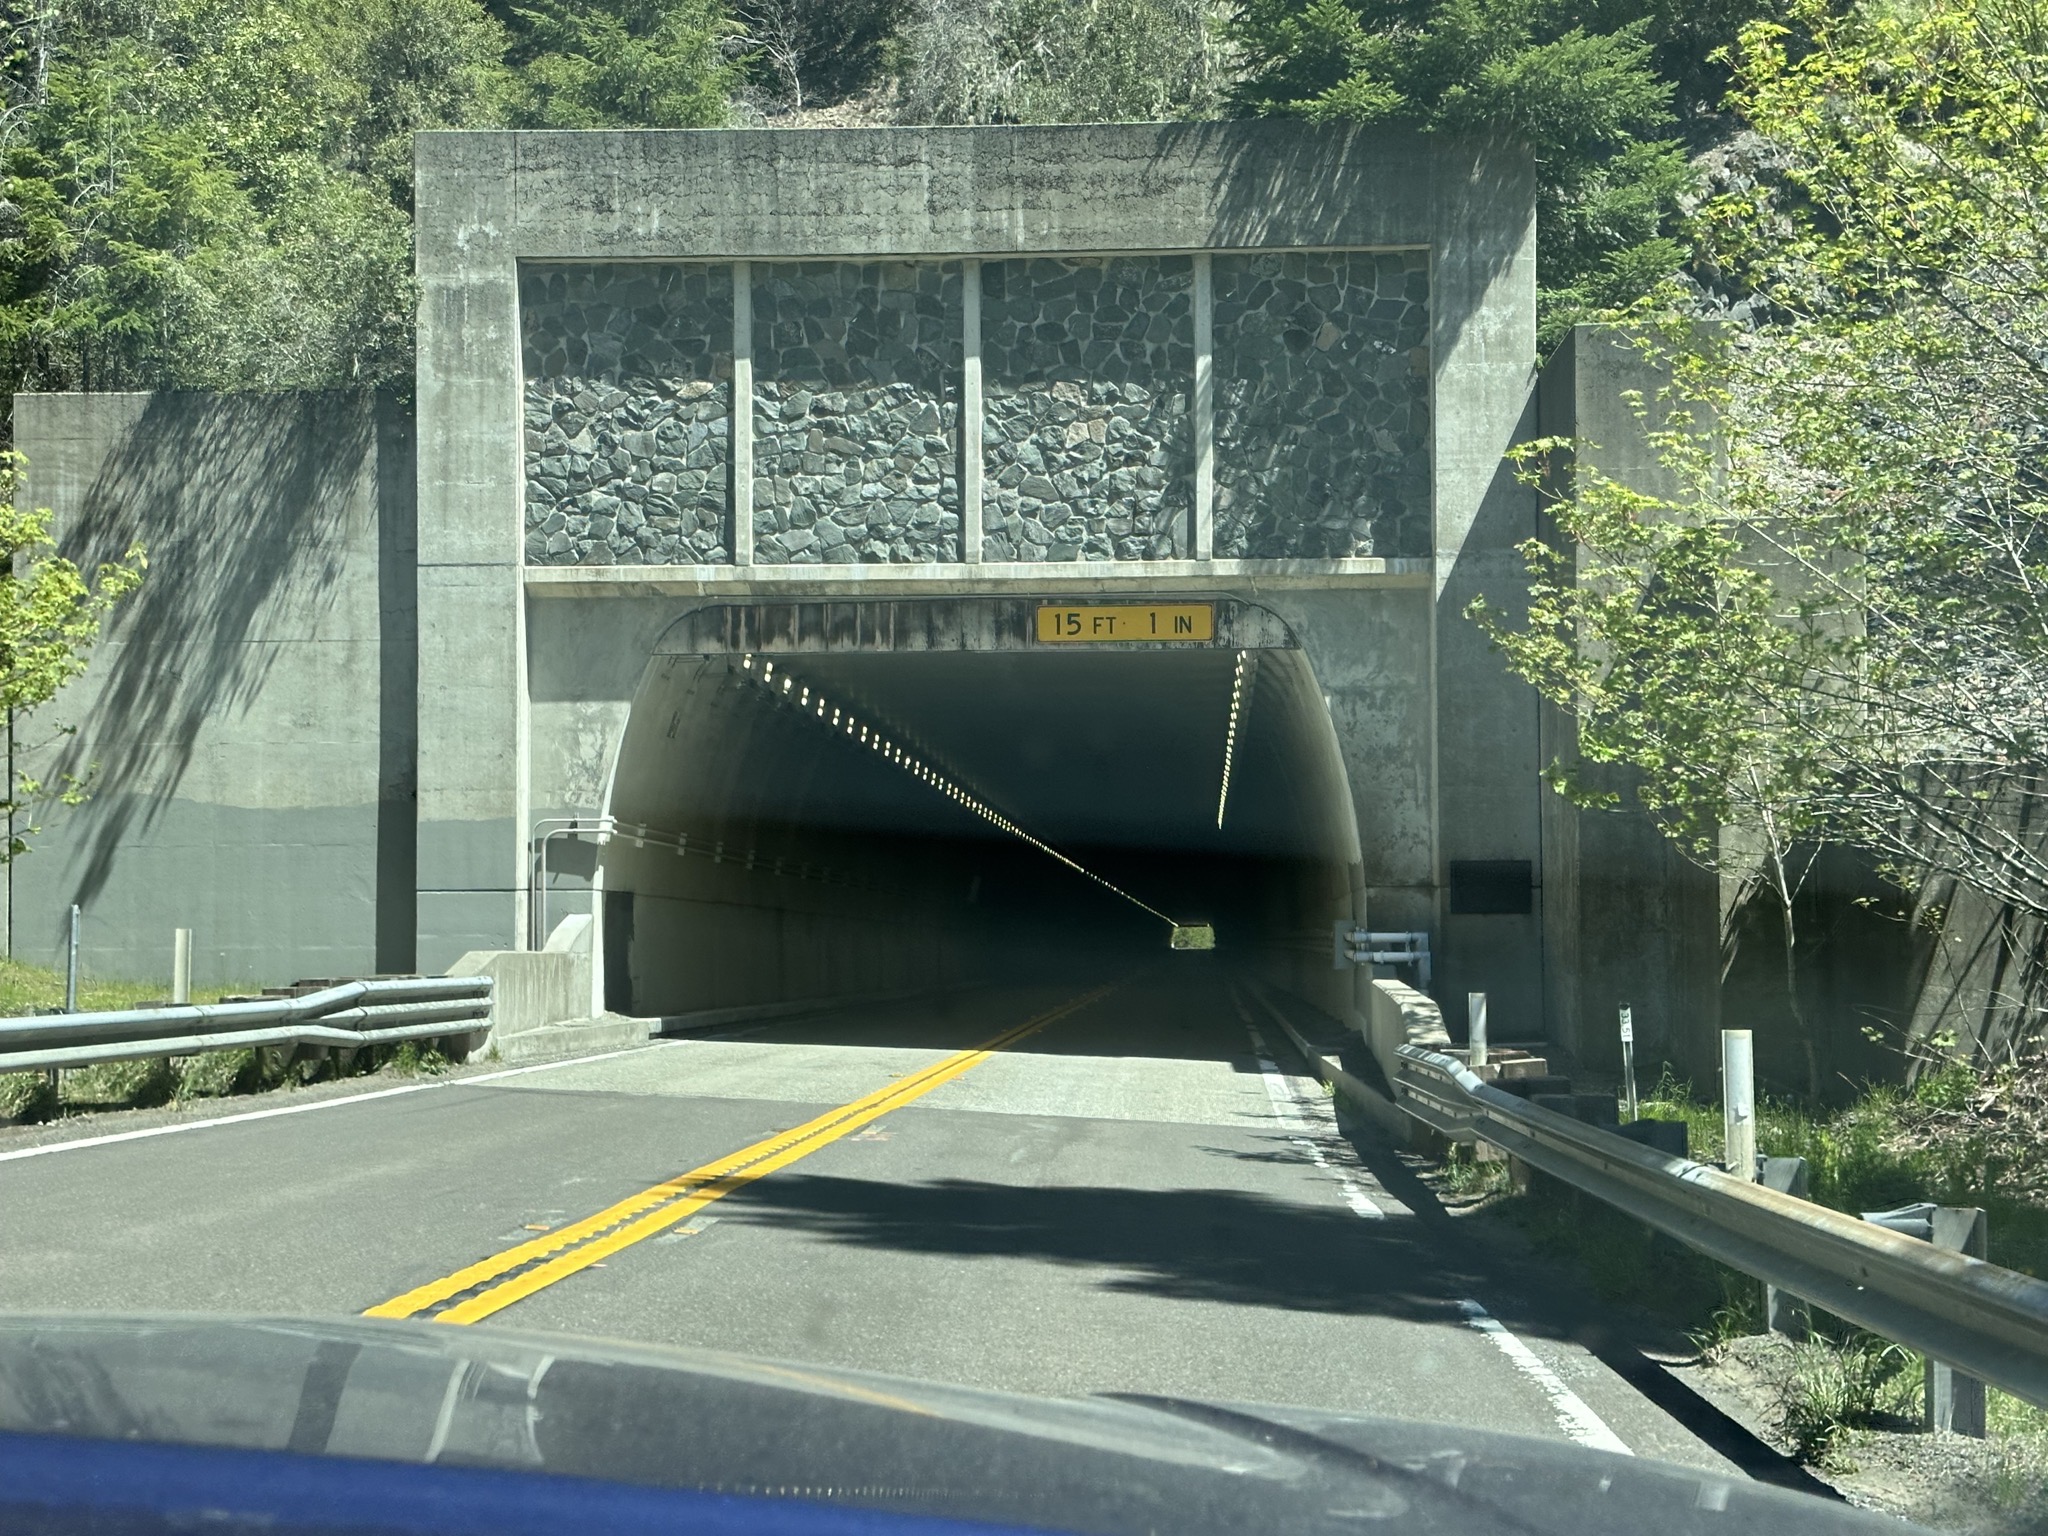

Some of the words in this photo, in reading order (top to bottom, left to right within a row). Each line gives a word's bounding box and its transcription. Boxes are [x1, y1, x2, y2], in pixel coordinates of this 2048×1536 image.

[1054, 613, 1082, 636] 15
[1093, 616, 1117, 635] FT
[1149, 612, 1157, 634] 1
[1174, 615, 1192, 634] IN
